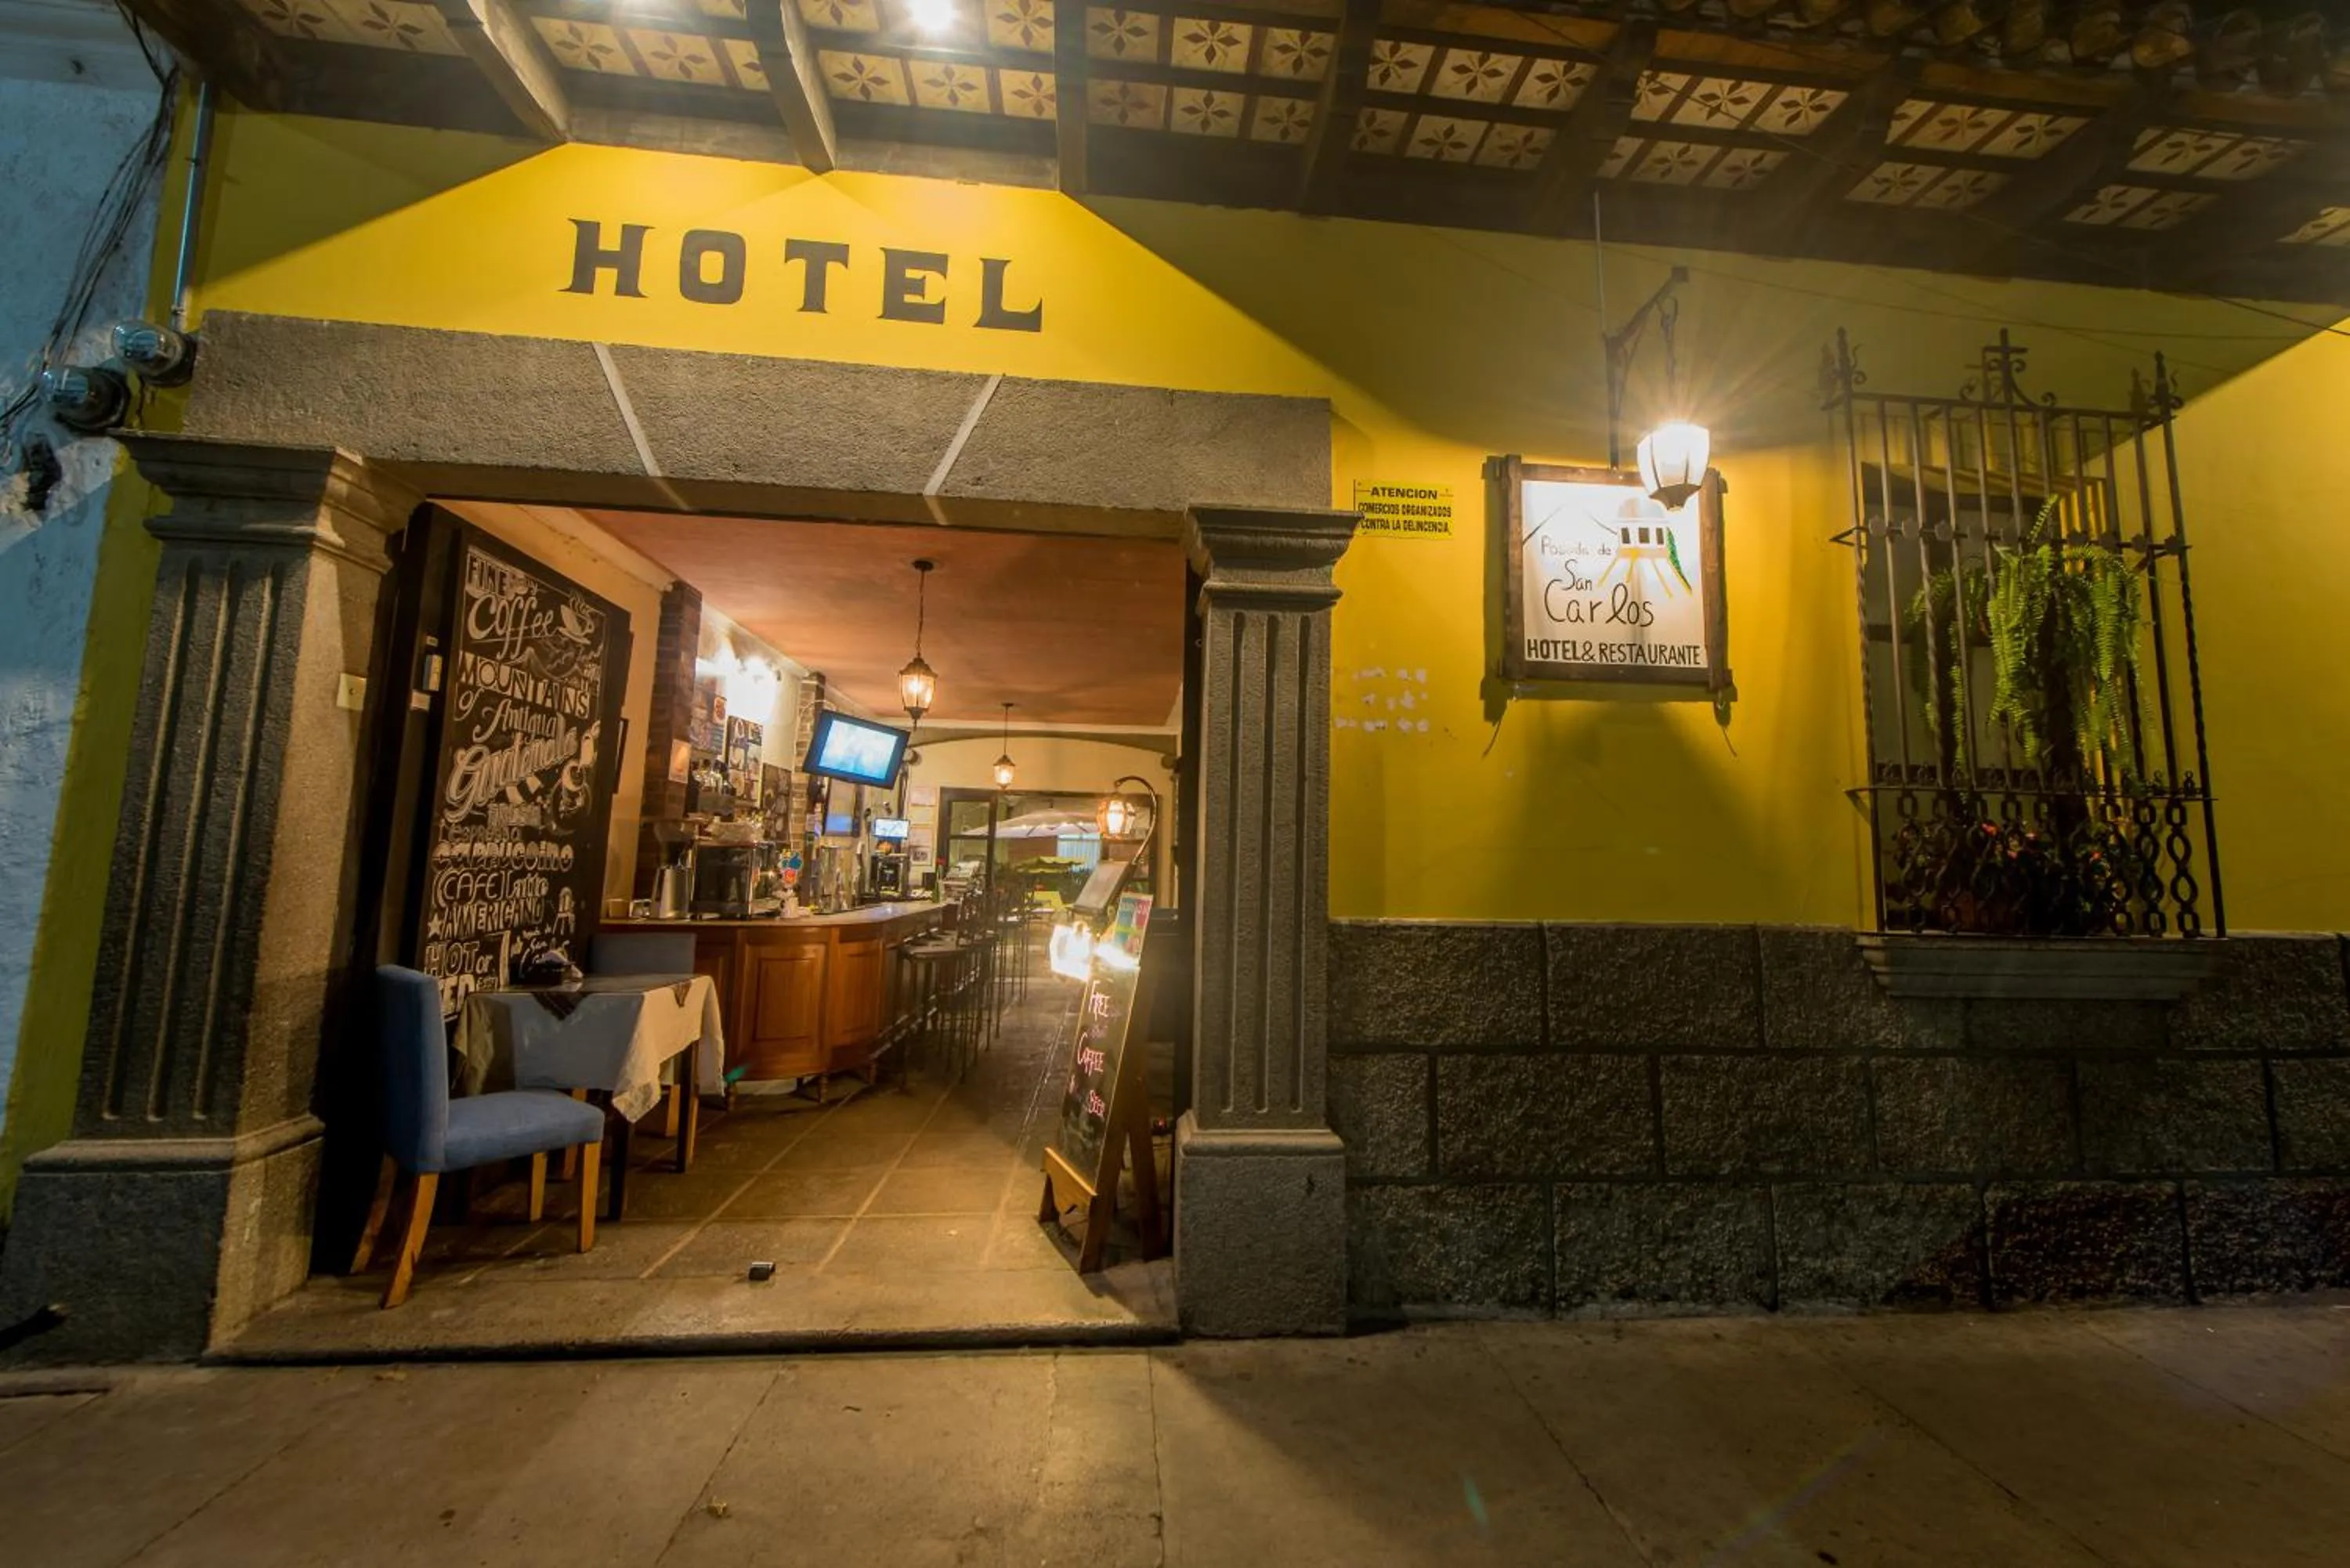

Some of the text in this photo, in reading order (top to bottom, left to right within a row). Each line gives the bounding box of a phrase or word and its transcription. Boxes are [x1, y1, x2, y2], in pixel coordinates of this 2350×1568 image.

[556, 217, 1043, 333] HOTEL
[1371, 486, 1438, 500] ATENCION
[1560, 558, 1593, 591] San
[1544, 582, 1655, 627] Carlos
[468, 594, 555, 660] Coffee
[1599, 642, 1701, 666] RESTAURANTE
[424, 941, 480, 977] HOT
